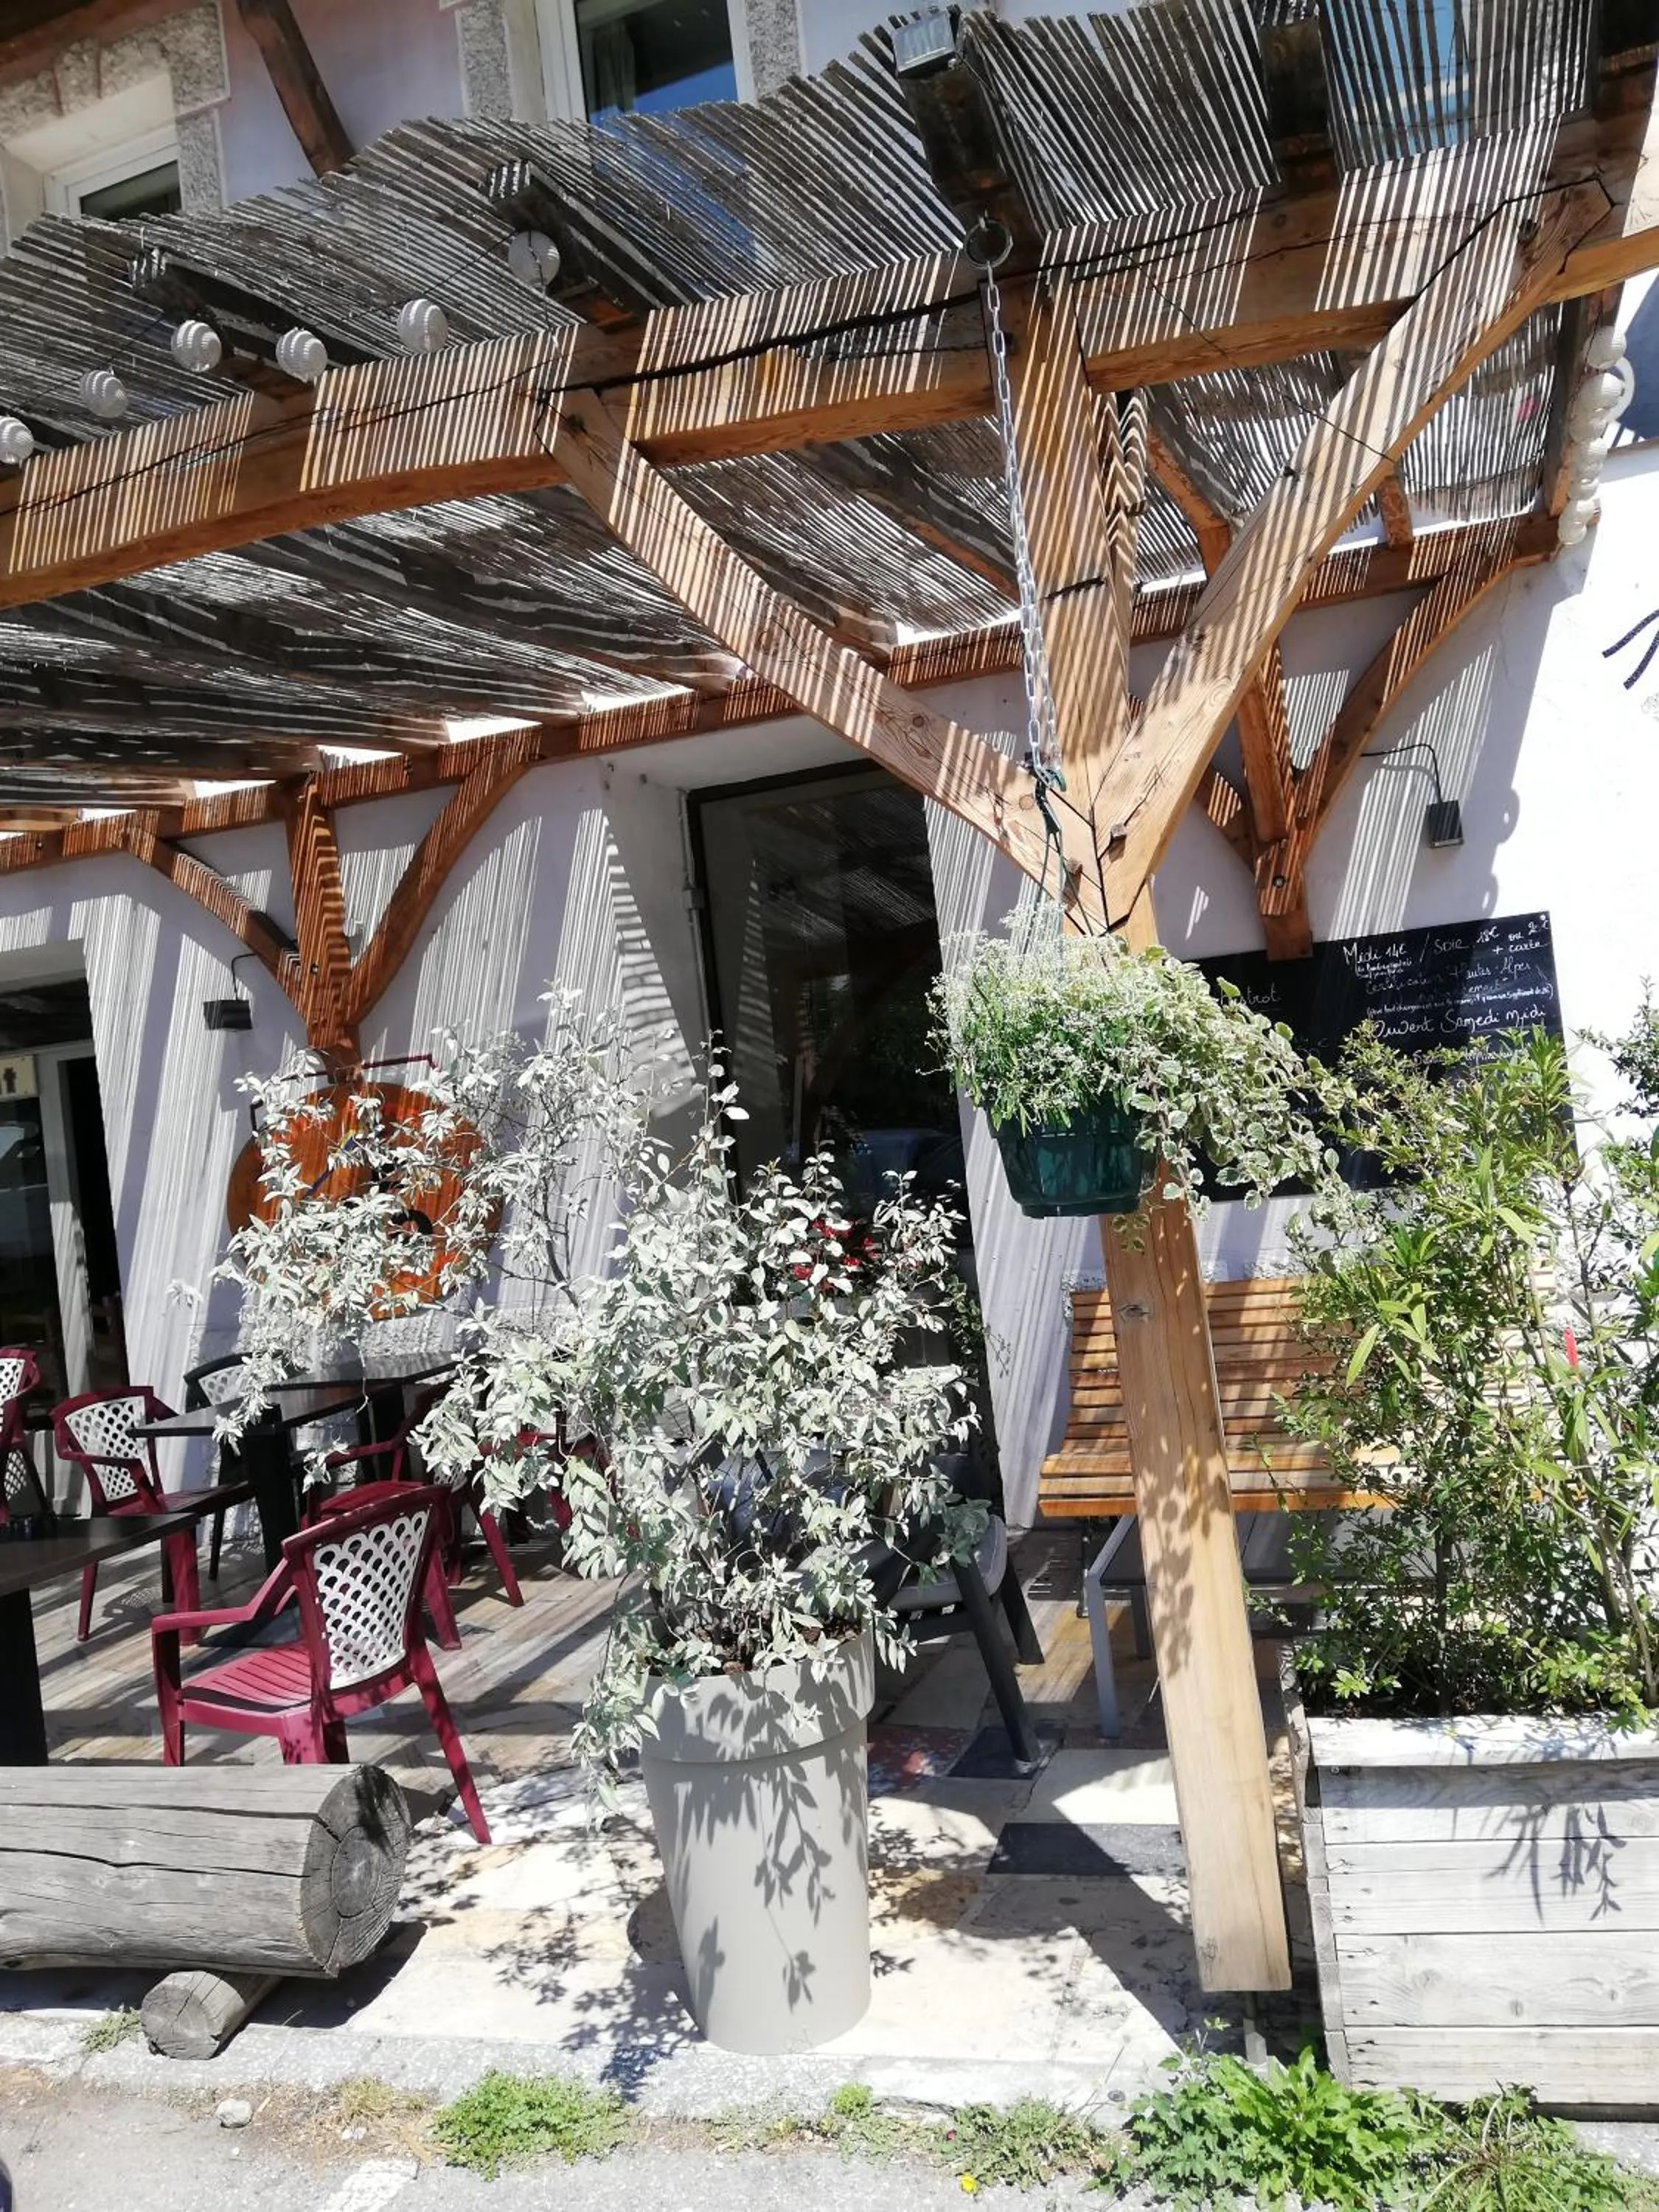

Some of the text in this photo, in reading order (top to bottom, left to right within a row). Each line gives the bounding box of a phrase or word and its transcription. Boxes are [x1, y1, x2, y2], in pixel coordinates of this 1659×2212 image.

[1343, 942, 1382, 967] Midi
[1373, 1017, 1436, 1039] Ouvert
[1440, 1009, 1500, 1034] Samedi
